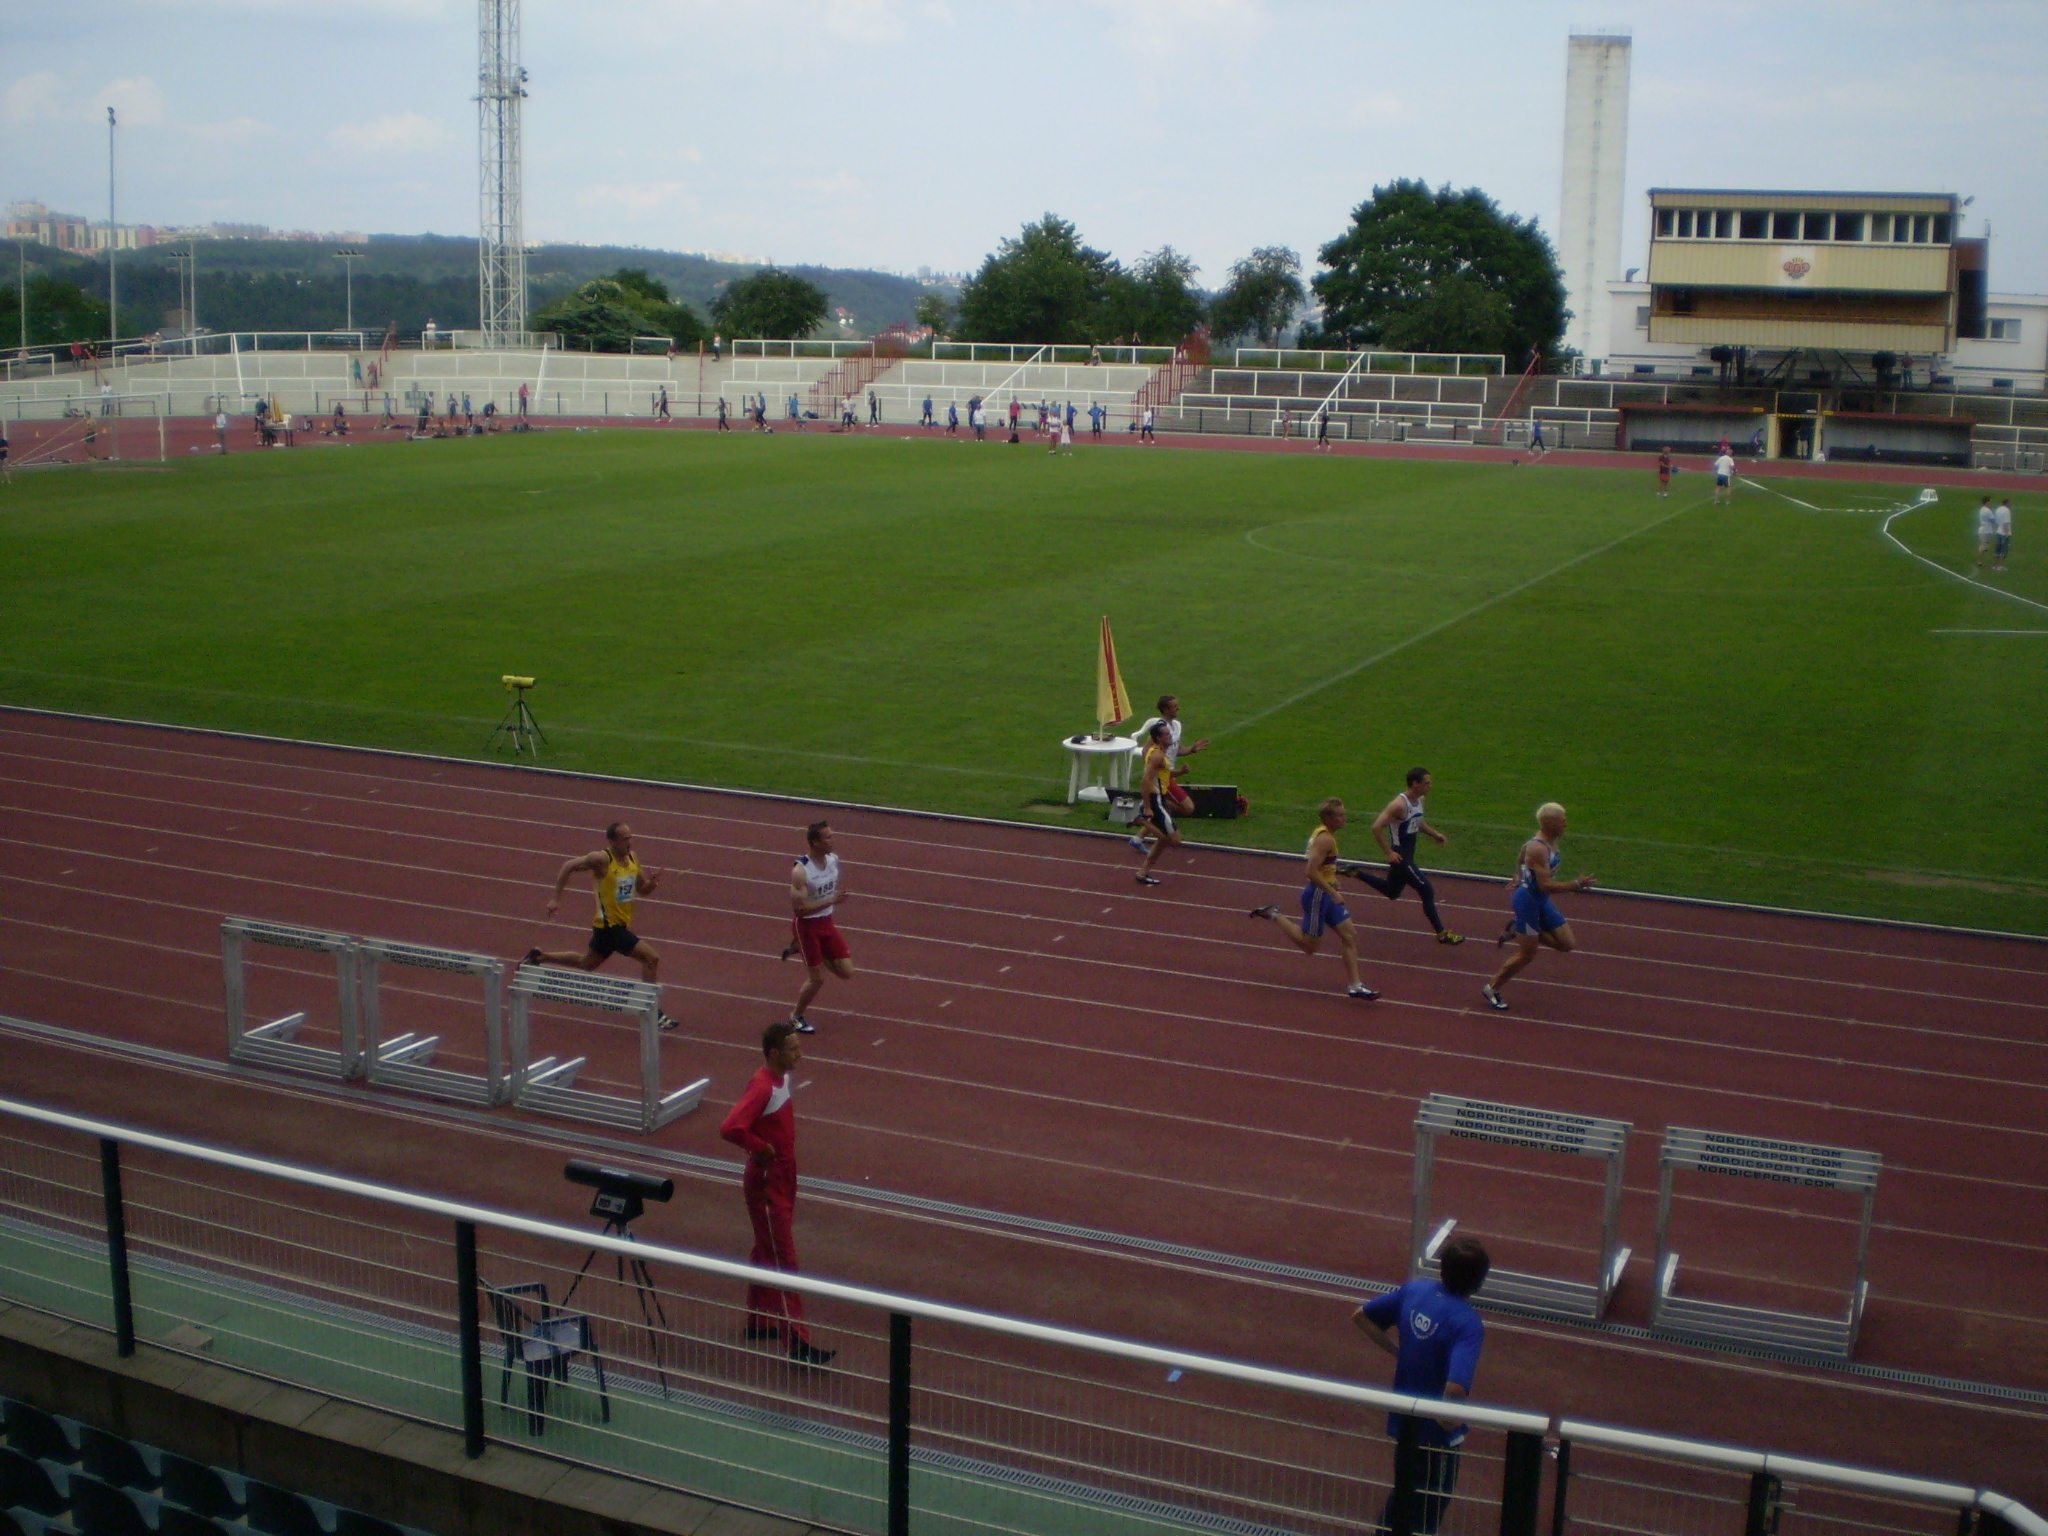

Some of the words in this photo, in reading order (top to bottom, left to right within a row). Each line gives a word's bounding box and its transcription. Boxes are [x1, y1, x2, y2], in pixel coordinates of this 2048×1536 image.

[386, 943, 471, 961] NORDICSPORT.COM
[539, 977, 630, 997] NORDICSPORT.COM
[544, 970, 635, 989] NORDICSPORT.COM
[532, 992, 623, 1012] NORDICSPORT.COM
[537, 985, 629, 1005] NORDICSPORT.COM
[1455, 1118, 1584, 1145] NORDICSPORT.COM
[1457, 1108, 1586, 1135] NORDICSPORT.COM
[1449, 1129, 1580, 1155] NORDICSPORT.COM
[1705, 1133, 1841, 1158] NORDICSPORT.COM
[1700, 1153, 1838, 1179] NORDICSPORT.COM
[1705, 1143, 1842, 1169] NORDICSPORT.COM
[1697, 1164, 1836, 1189] NORDICSPORT.COM
